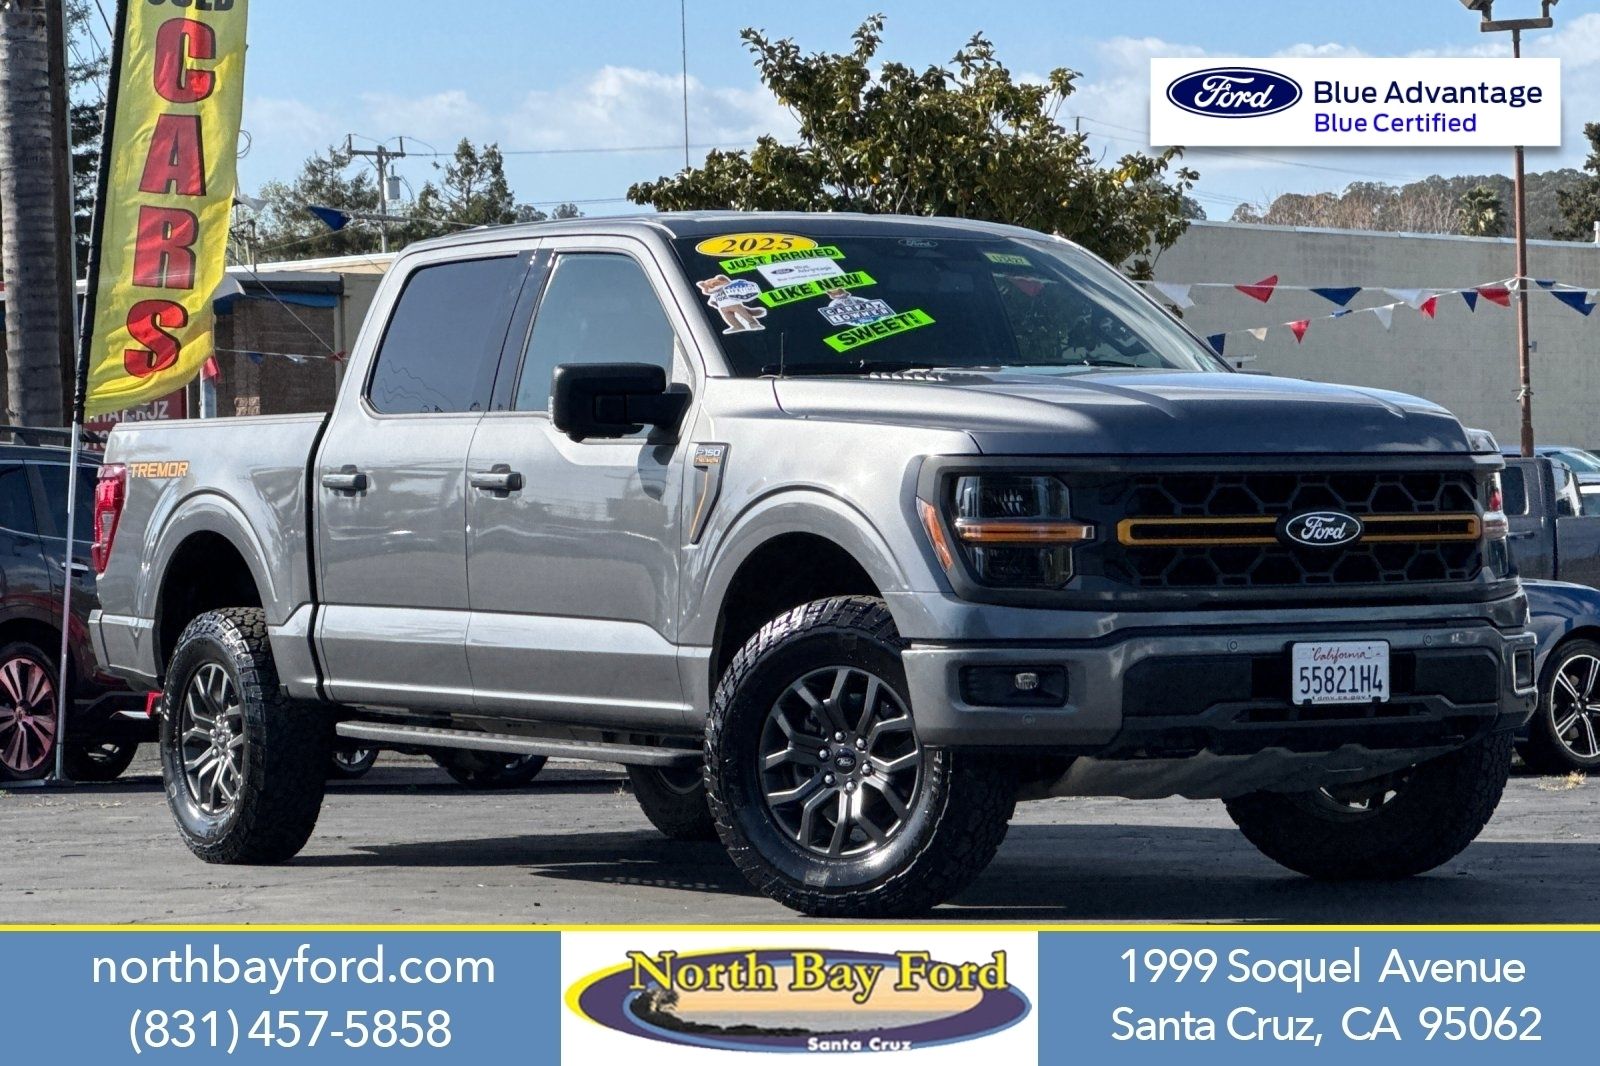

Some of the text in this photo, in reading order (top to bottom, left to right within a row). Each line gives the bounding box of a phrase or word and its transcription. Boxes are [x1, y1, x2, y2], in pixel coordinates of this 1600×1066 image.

[124, 17, 216, 379] CARS
[720, 237, 794, 254] 2025
[727, 248, 839, 271] JUST ARRIVED
[768, 281, 813, 303] LIKE
[816, 273, 863, 291] NEW
[826, 301, 882, 315] CARFAX
[842, 308, 889, 321] OWNER
[837, 312, 921, 346] SWEET!
[129, 462, 189, 478] TREMOR
[1301, 516, 1346, 540] Ford
[1313, 647, 1371, 664] California
[1300, 664, 1383, 694] 55821H4
